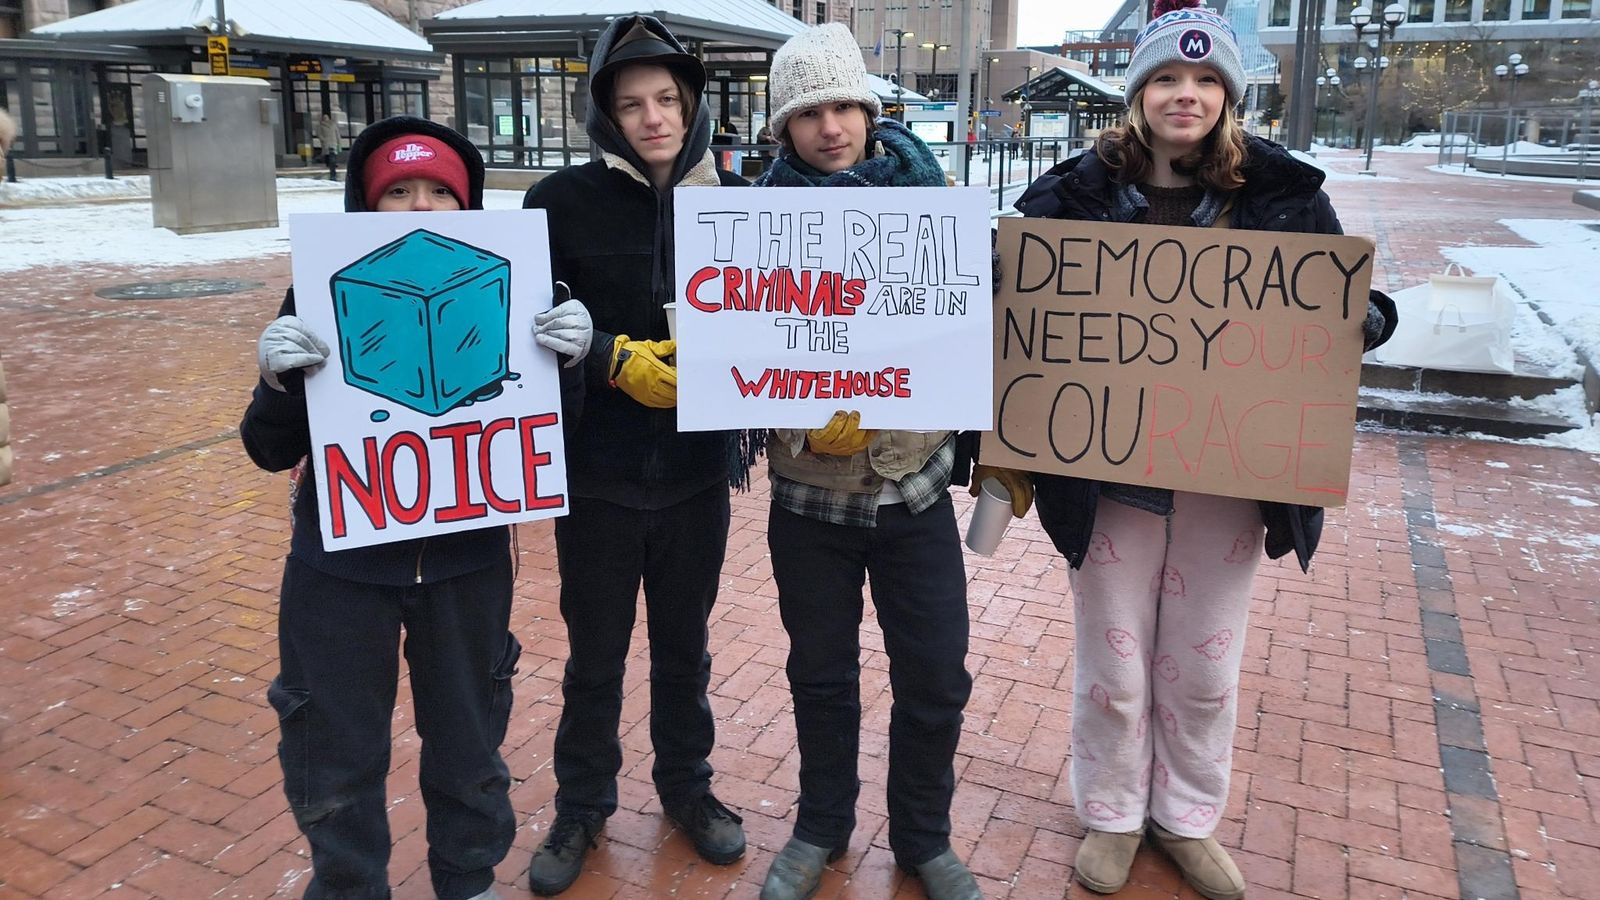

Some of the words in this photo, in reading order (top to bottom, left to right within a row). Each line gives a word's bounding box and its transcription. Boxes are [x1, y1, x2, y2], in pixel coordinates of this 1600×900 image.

[1185, 38, 1204, 54] M
[394, 149, 433, 162] Pepper
[406, 143, 424, 153] Dr
[697, 211, 823, 269] THE
[843, 209, 980, 286] REAL
[686, 266, 867, 316] CRIMINALS
[867, 285, 926, 316] ARE
[935, 288, 967, 316] IN
[1016, 232, 1370, 320] DEMOCRACY
[775, 317, 849, 354] THE
[1003, 307, 1179, 366] NEEDS
[1190, 317, 1333, 377] YOUR
[998, 374, 1352, 496] COURAGE
